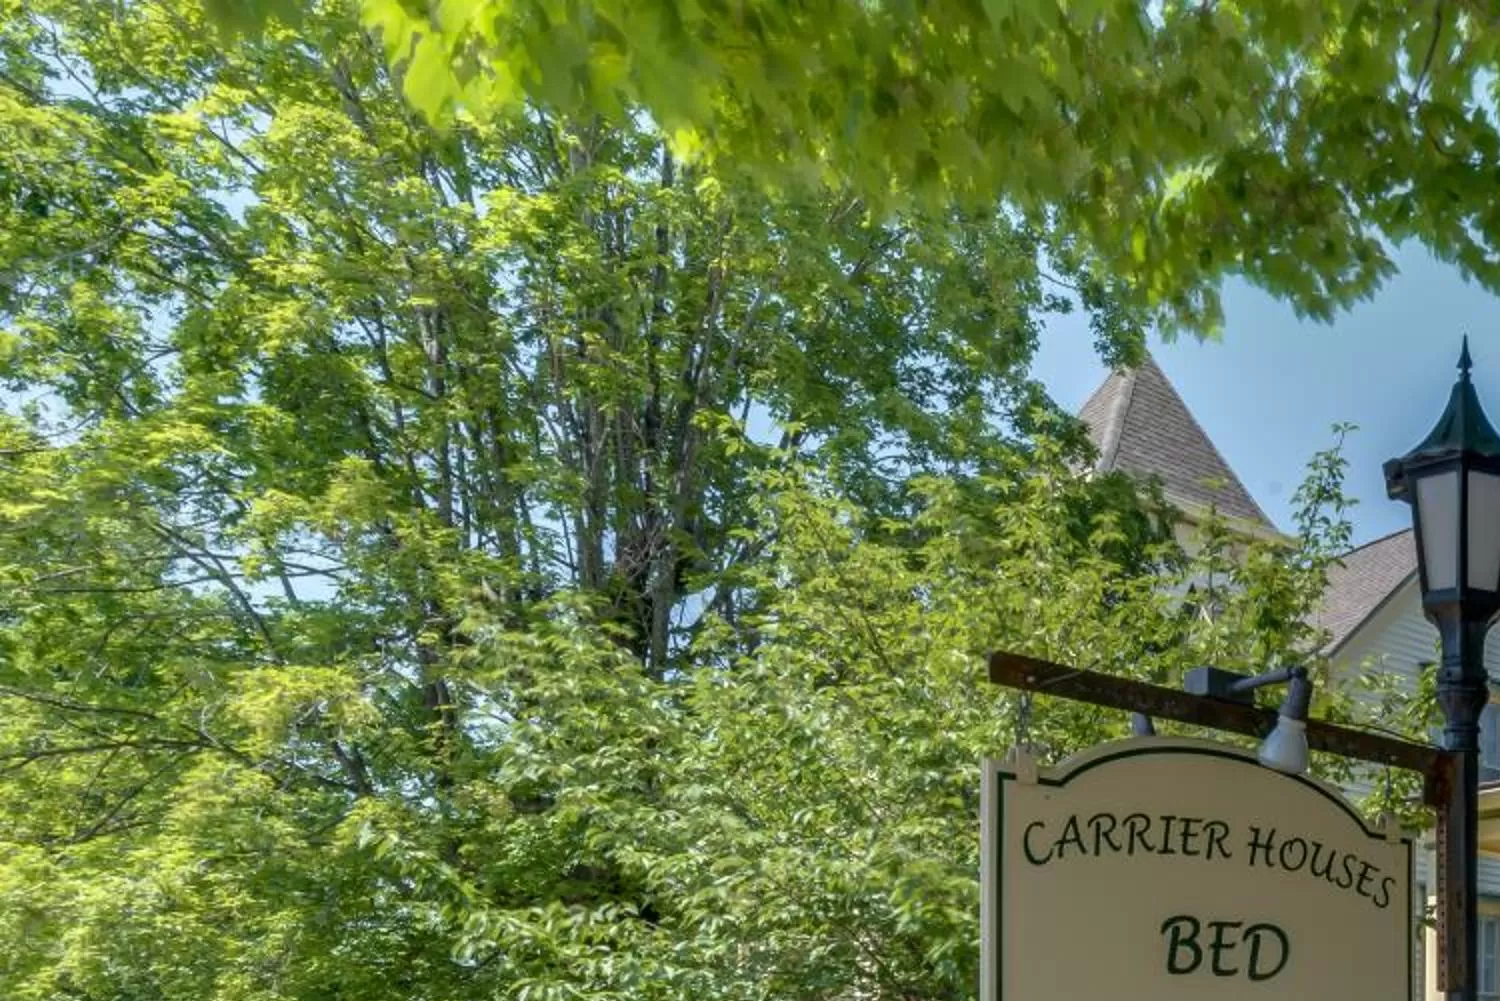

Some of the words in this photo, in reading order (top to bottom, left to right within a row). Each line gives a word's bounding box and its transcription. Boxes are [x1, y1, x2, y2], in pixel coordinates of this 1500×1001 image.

[1022, 812, 1232, 866] CARRIER
[1247, 826, 1397, 909] HOUSES
[1160, 914, 1290, 982] BED
